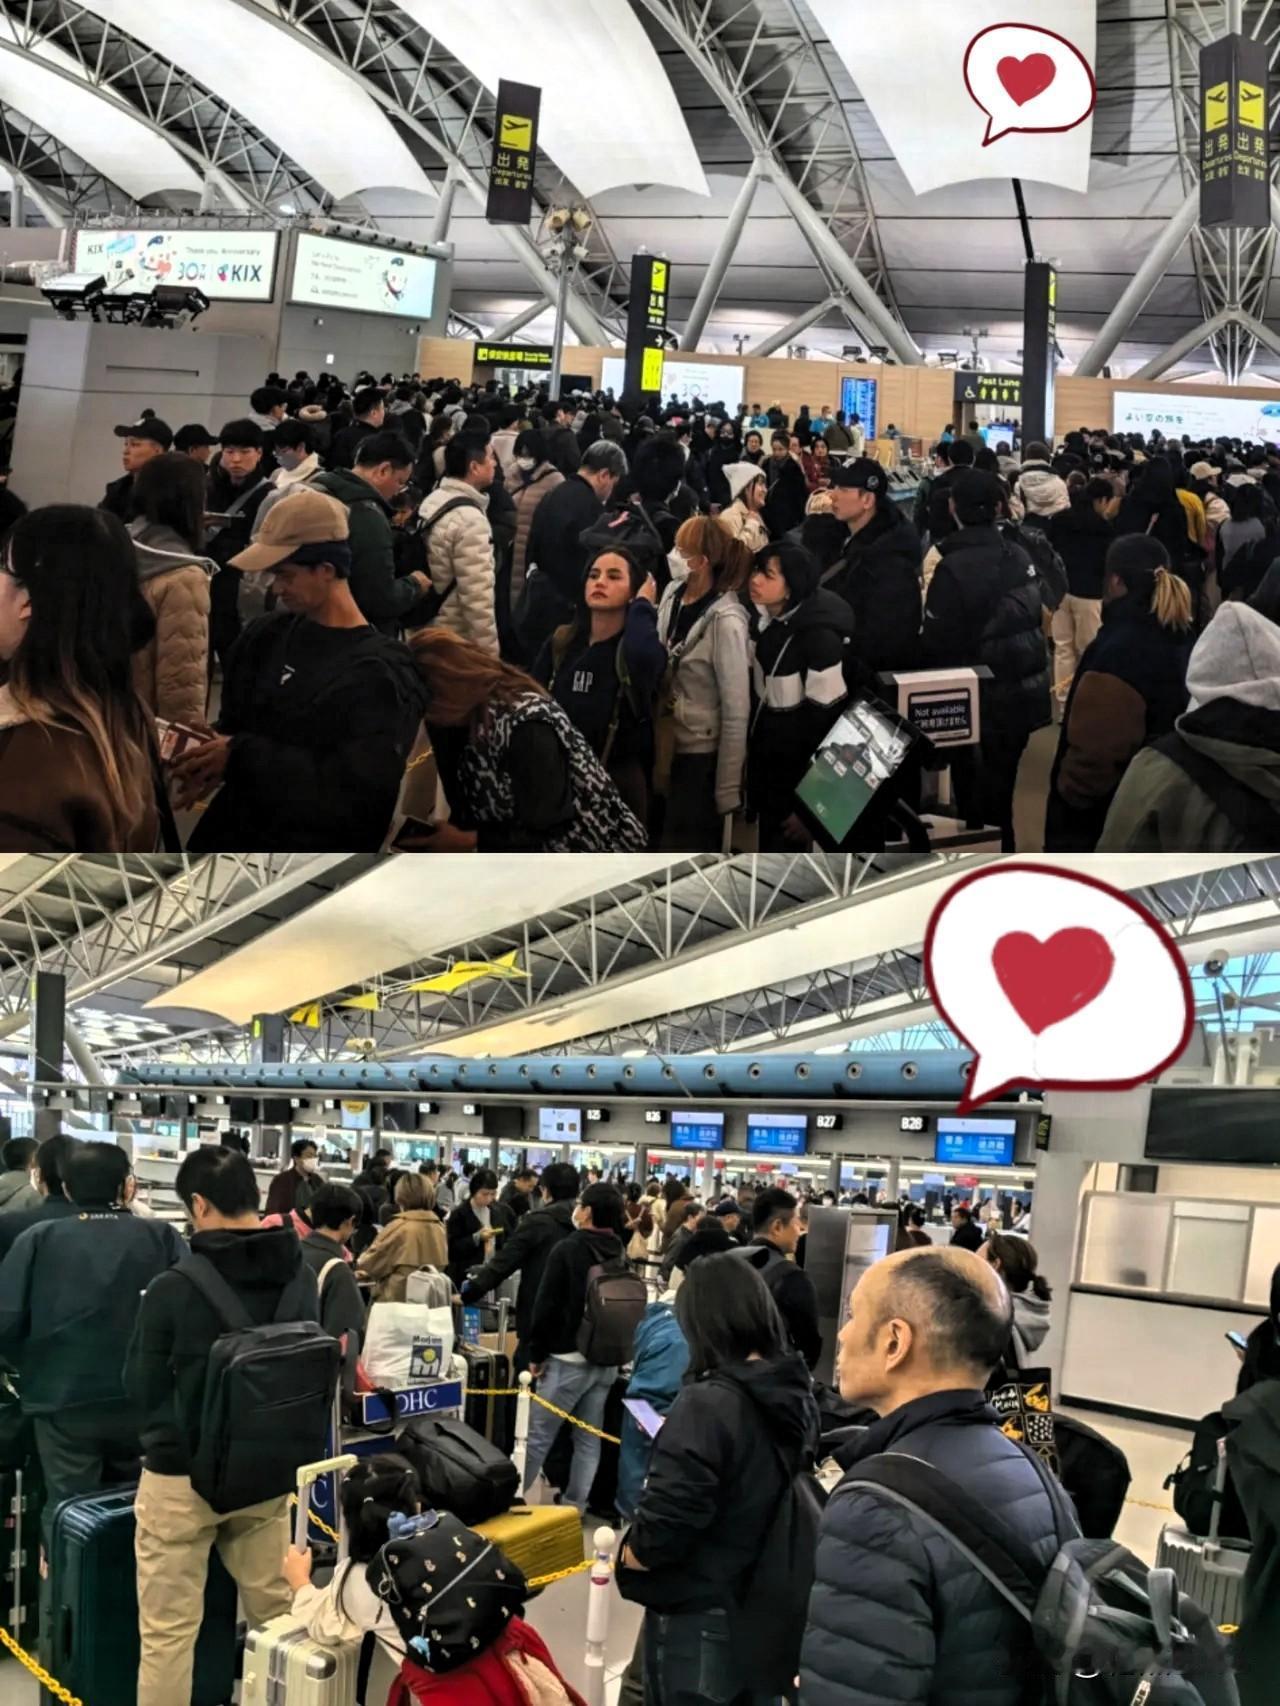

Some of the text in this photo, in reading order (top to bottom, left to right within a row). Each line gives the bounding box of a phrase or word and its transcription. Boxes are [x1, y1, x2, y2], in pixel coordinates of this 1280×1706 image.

[492, 166, 532, 181] Departures
[231, 264, 263, 282] KIX
[977, 375, 1020, 388] Fast Lane
[1125, 412, 1184, 425] よい空の旅を
[914, 703, 966, 718] Not available
[645, 1110, 662, 1122] B26
[816, 1114, 837, 1129] B27
[900, 1116, 923, 1131] B28
